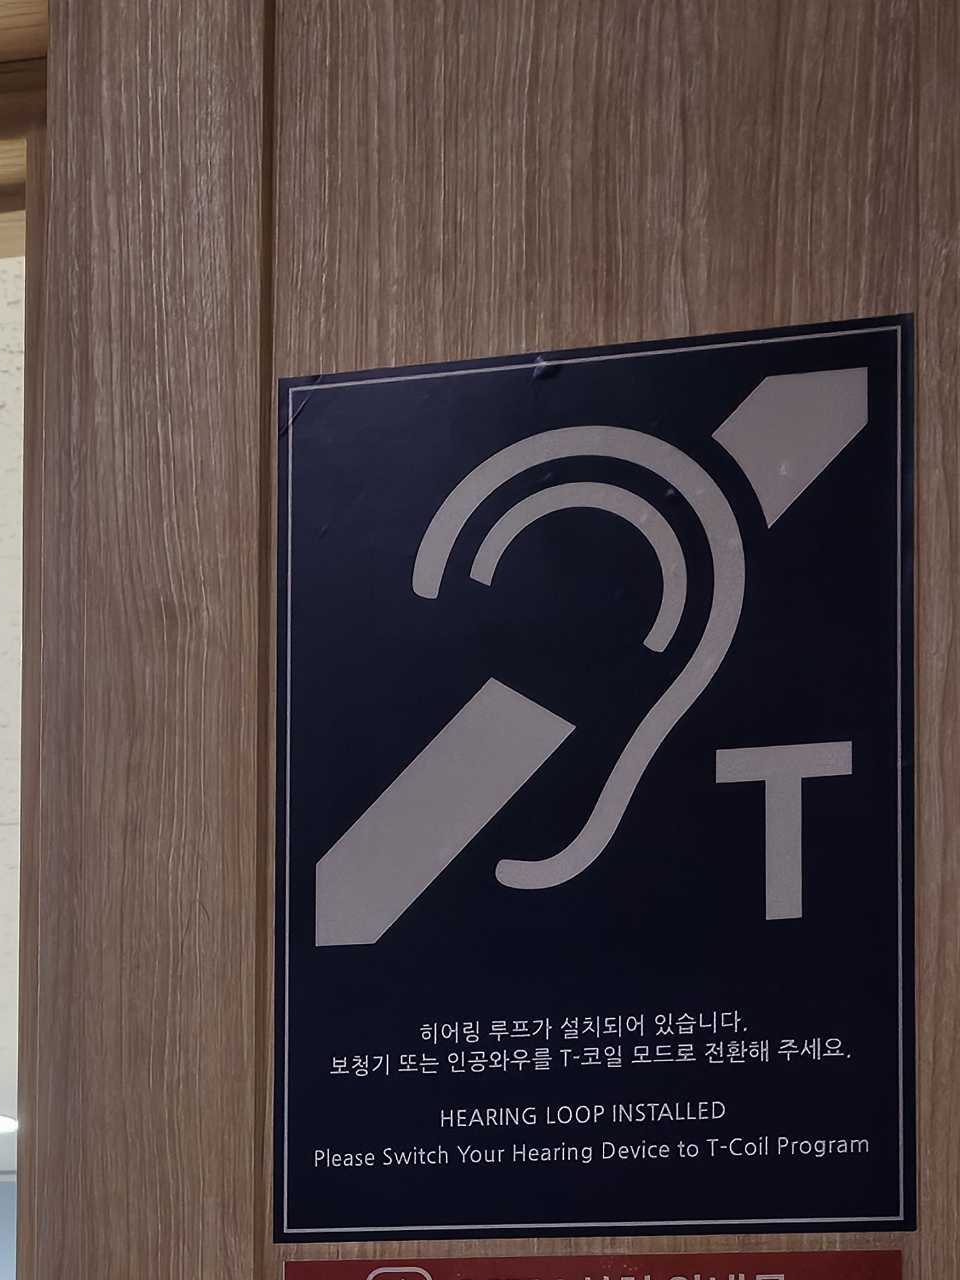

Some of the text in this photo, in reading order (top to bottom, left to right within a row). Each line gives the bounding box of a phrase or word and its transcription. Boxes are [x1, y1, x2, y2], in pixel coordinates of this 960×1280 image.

[715, 740, 853, 921] T
[419, 1010, 748, 1045] 히어링 루프가 설치되어 있습니다.
[329, 1037, 851, 1077] 보청기 또는 인공와우를 T-코일 모드로 전환해 주세요.
[440, 1101, 726, 1128] HEARING LOOP INSTALLED
[314, 1135, 869, 1167] Please Switch Your Hearing Device to T-Coil Program
